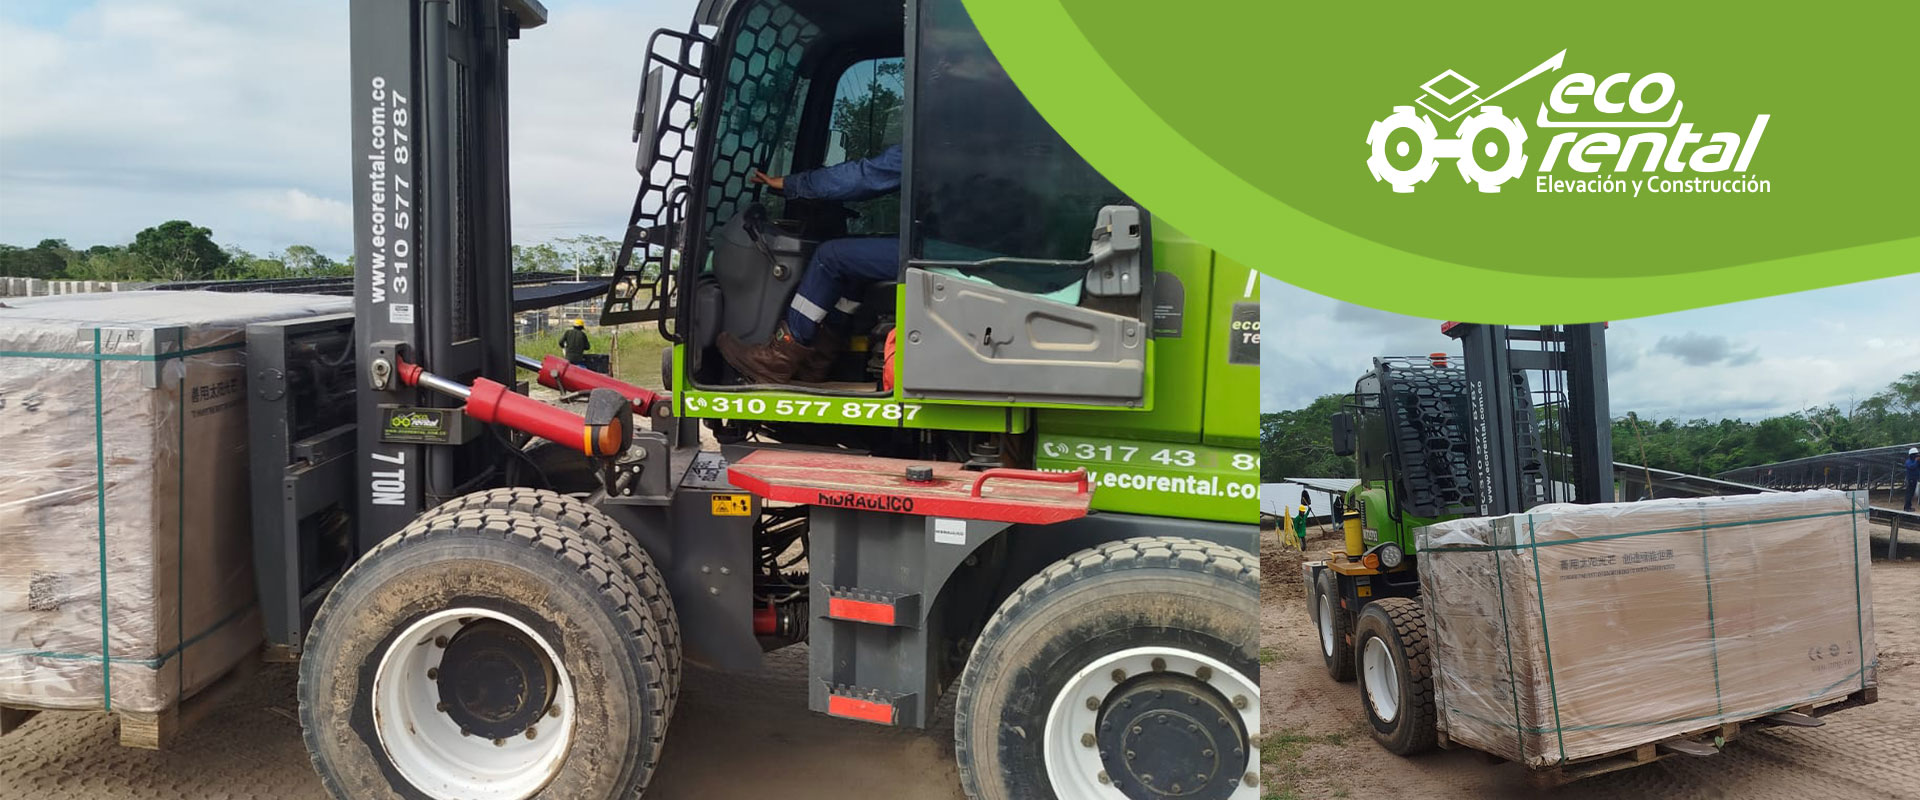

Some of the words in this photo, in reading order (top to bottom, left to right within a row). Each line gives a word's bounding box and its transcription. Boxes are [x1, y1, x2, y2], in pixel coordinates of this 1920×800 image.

[392, 89, 408, 165] 8787
[368, 76, 386, 303] www.ecorental.com.co
[395, 174, 409, 230] 577
[393, 239, 408, 293] 310
[711, 397, 766, 414] 310
[775, 399, 832, 417] 577
[842, 402, 923, 421] 8787
[371, 451, 405, 464] 7
[1075, 443, 1139, 462] 317
[1231, 453, 1260, 471] 8
[371, 469, 406, 506] TON
